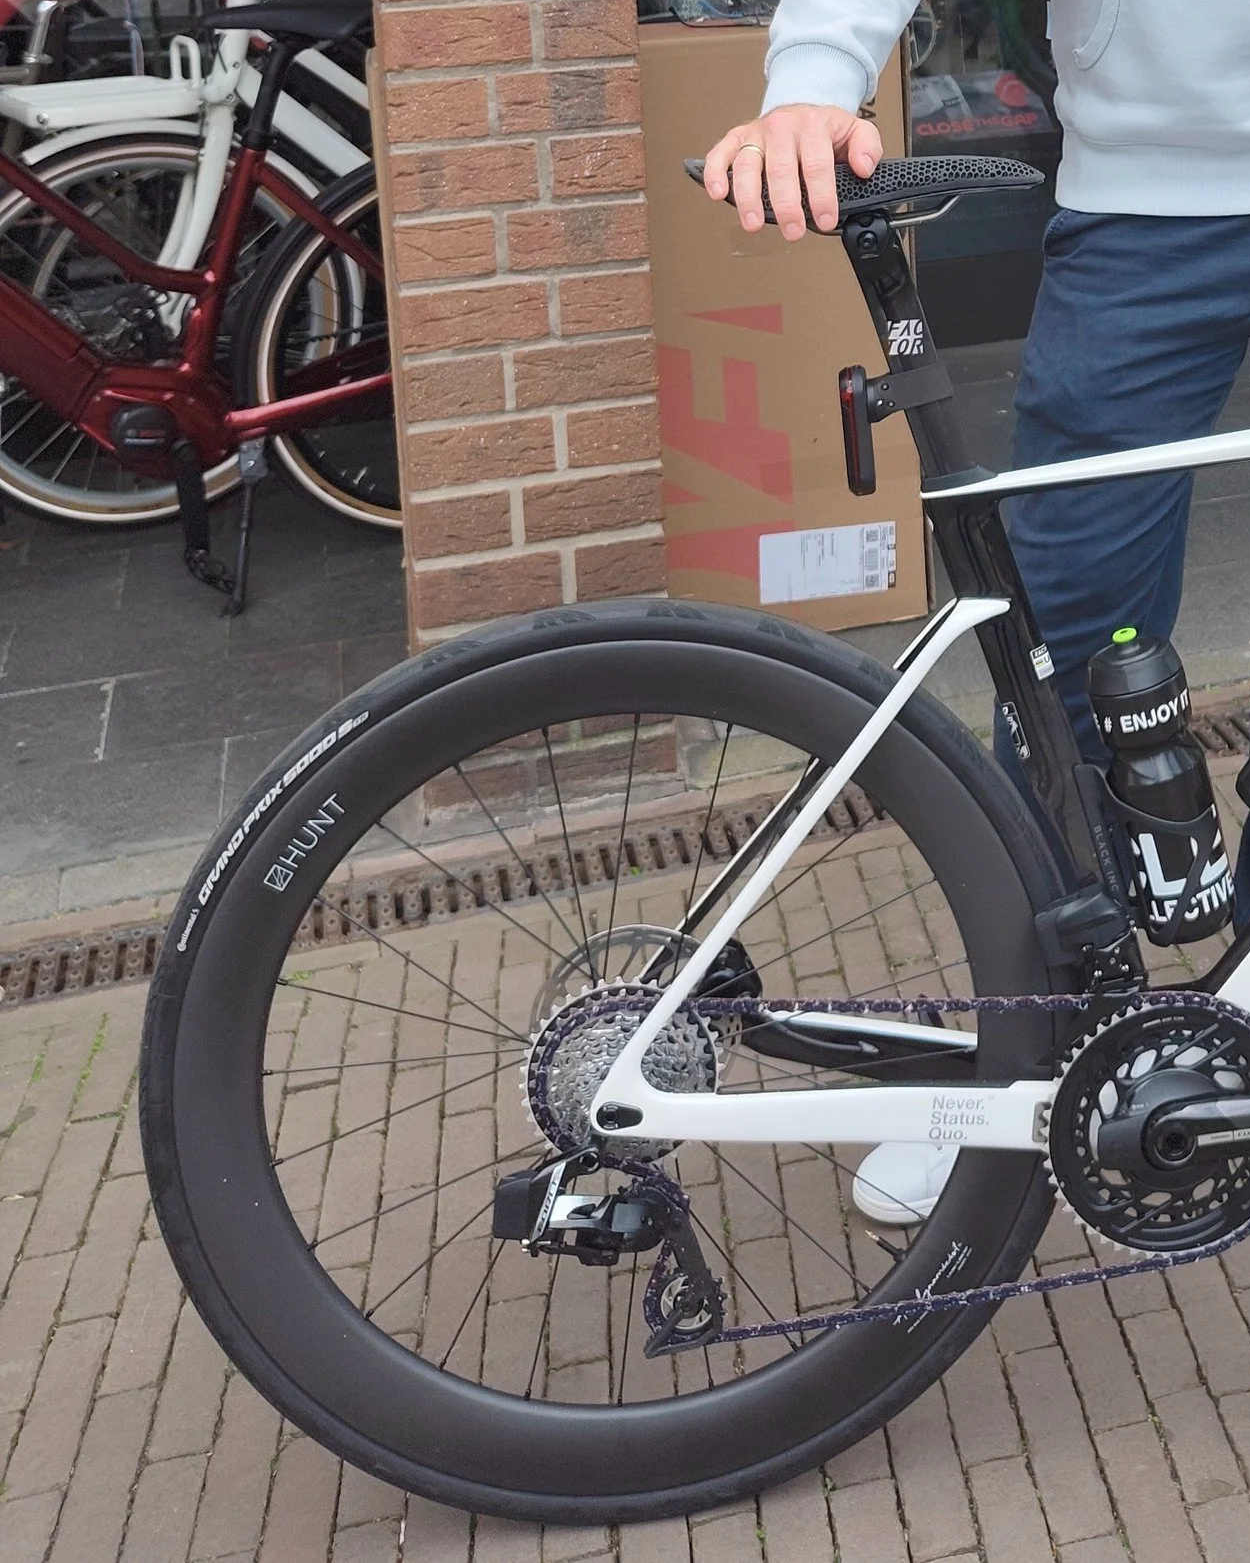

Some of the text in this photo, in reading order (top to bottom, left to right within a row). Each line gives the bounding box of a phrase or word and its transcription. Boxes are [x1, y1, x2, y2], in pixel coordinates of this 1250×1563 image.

[916, 116, 975, 137] CLOSE
[1001, 111, 1040, 128] GAP
[1119, 701, 1178, 734] ENJOY
[1179, 688, 1190, 711] IT
[198, 828, 245, 906] GRAND
[242, 780, 283, 834] PRIX
[279, 793, 346, 868] HUNT
[932, 1095, 984, 1110] Never.
[931, 1111, 989, 1125] Status.
[928, 1126, 968, 1140] Quo.
